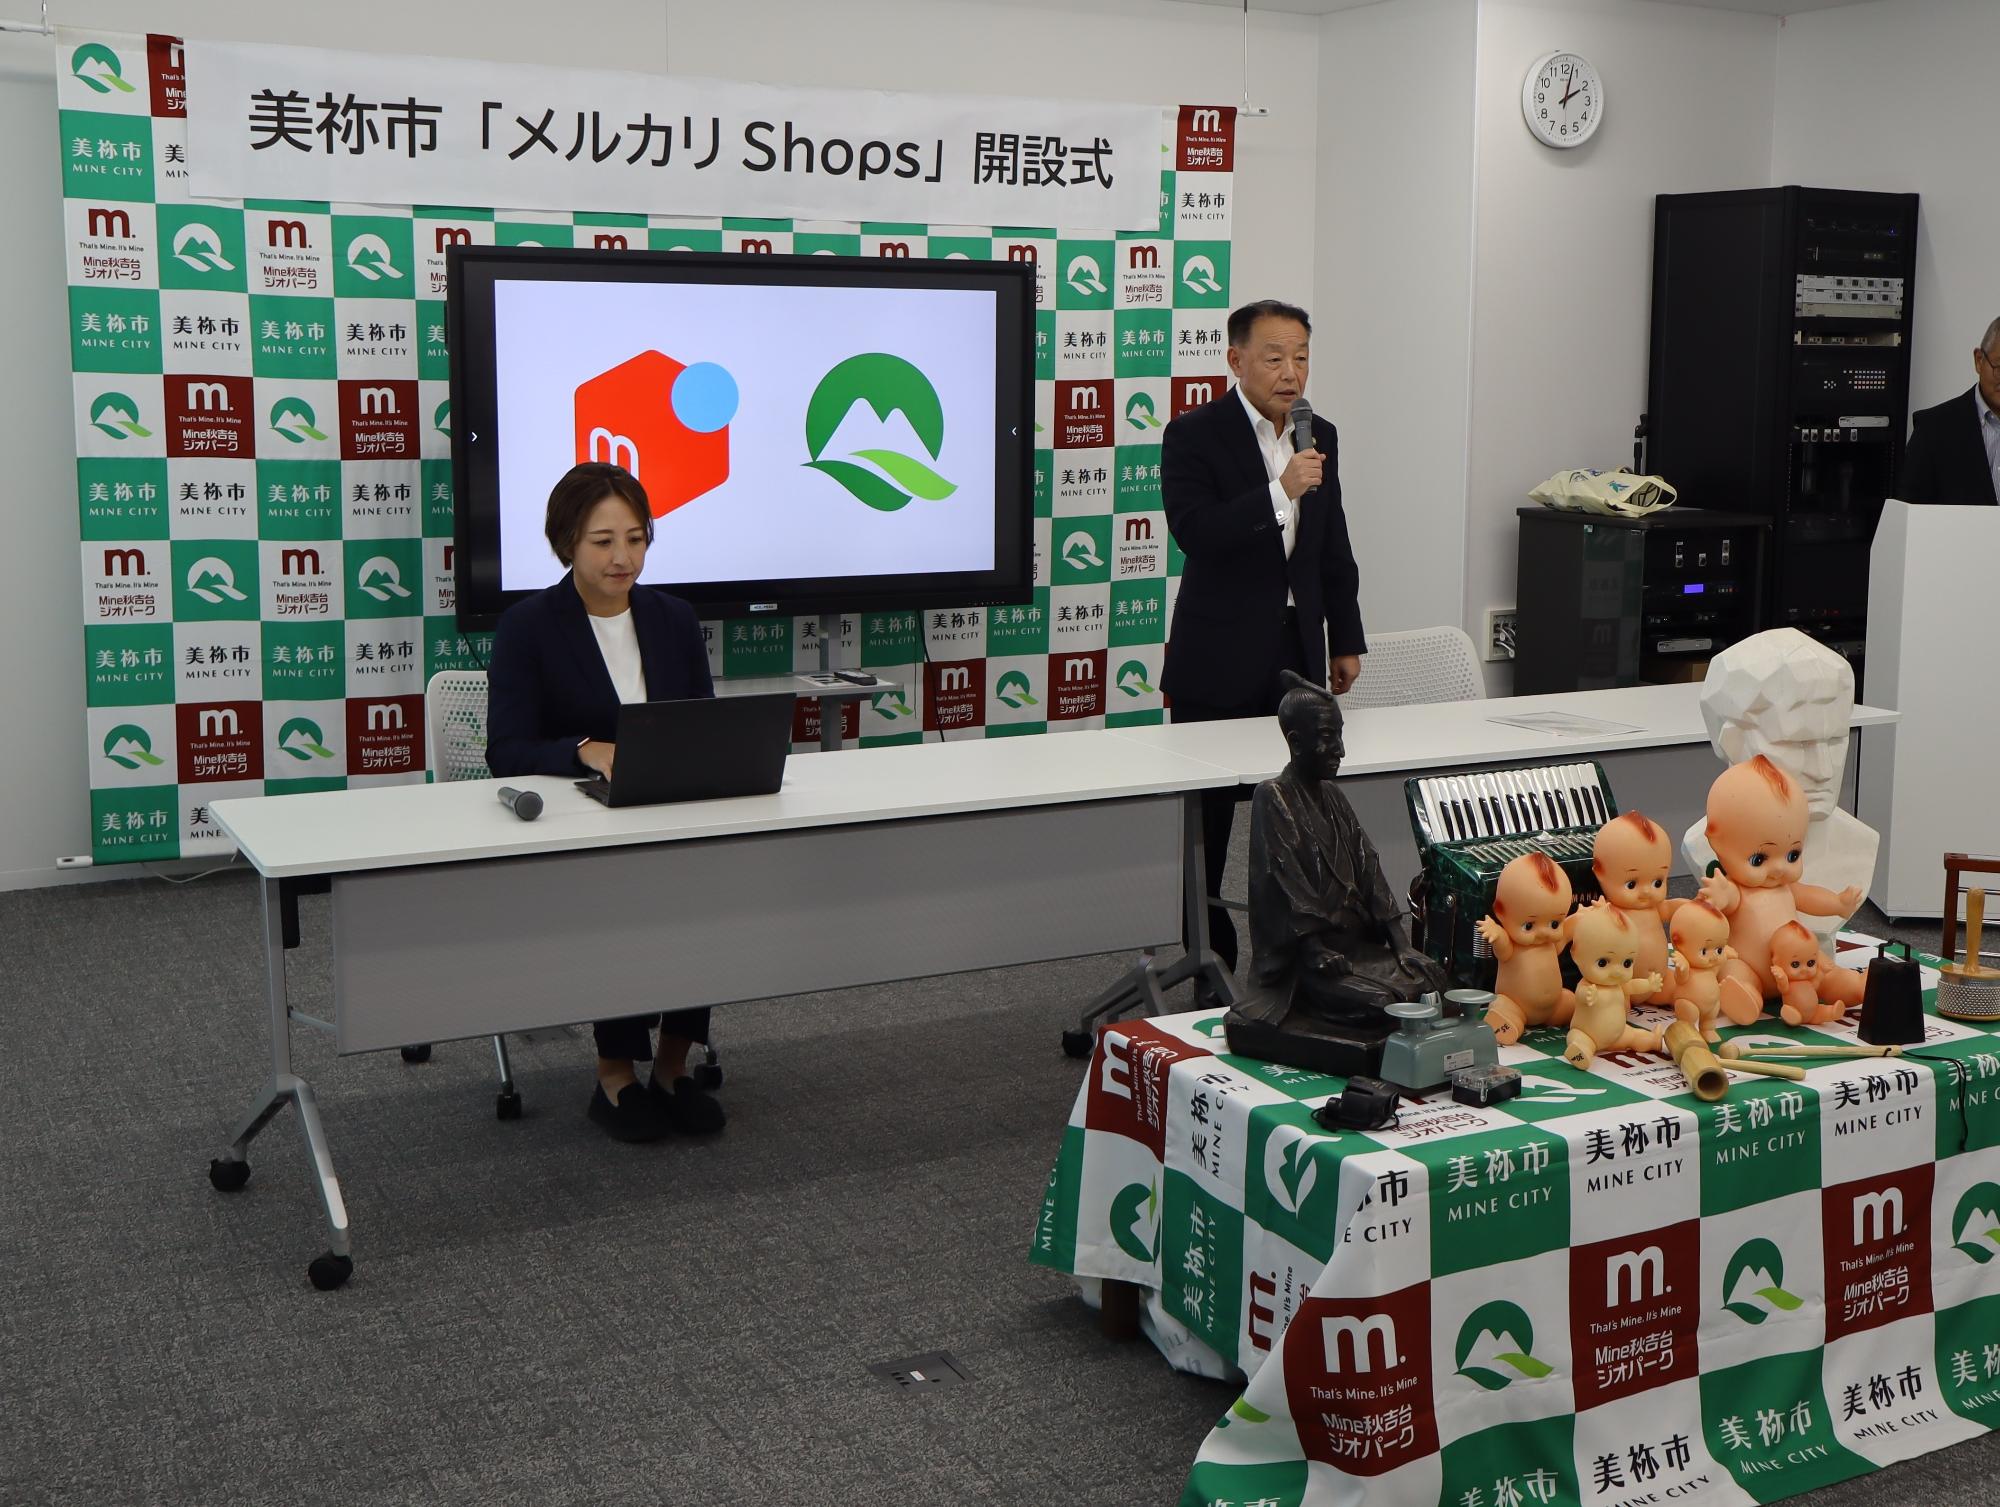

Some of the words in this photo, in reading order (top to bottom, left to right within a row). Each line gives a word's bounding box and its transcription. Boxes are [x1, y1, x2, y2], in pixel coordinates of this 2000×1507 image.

[1550, 67, 1556, 77] 11
[1561, 64, 1570, 74] 12
[1575, 68, 1578, 78] 1
[1541, 78, 1550, 88] 10
[1582, 80, 1588, 90] 2
[1538, 93, 1544, 103] 9
[1584, 96, 1590, 106] 3
[1541, 108, 1548, 118] 8
[1581, 111, 1587, 122] 4
[1550, 120, 1556, 130] 7
[1560, 125, 1567, 135] 6
[1573, 122, 1579, 132] 5
[72, 138, 141, 160] 美祢市
[73, 164, 106, 173] MINE
[114, 167, 142, 176] CITY
[1182, 193, 1224, 208] 美祢市
[84, 256, 140, 270] Mine秋吉台
[85, 268, 141, 281] ジオパーク
[81, 313, 149, 334] 美祢市
[173, 316, 239, 336] 美祢市
[262, 321, 324, 340] 美祢市
[347, 324, 406, 342] 美祢市
[1064, 332, 1106, 347] 美祢市
[81, 339, 115, 348] MINE
[122, 340, 151, 348] CITY
[173, 340, 206, 350] MINE
[212, 342, 240, 351] CITY
[262, 345, 292, 353] MINE
[299, 347, 326, 355] CITY
[183, 429, 237, 440] Mine秋吉台
[184, 440, 238, 451] ジオパーク
[1062, 468, 1106, 484] 美祢市
[180, 482, 245, 501] 美祢市
[353, 484, 411, 501] 美祢市
[218, 507, 246, 515] CITY
[99, 595, 154, 605] Mine秋吉台
[277, 594, 328, 604] Mine秋吉台
[100, 606, 155, 616] ジオパーク
[278, 604, 328, 614] ジオパーク
[1058, 604, 1103, 621] 美祢市
[187, 645, 250, 664] 美祢市
[357, 642, 413, 660] 美祢市
[186, 670, 216, 678] MINE
[356, 666, 384, 674] MINE
[391, 664, 413, 672] CITY
[194, 753, 246, 764] Mine秋吉台
[195, 764, 247, 776] ジオパーク
[102, 810, 168, 831] 美祢市
[102, 836, 133, 844] MINE
[140, 833, 168, 842] CITY
[1216, 1086, 1250, 1110] CITY
[1831, 1069, 1919, 1110] 美祢市
[1191, 1074, 1232, 1170] 美祢市
[1712, 1091, 1803, 1138] 美祢市
[1834, 1116, 1877, 1136] MINE
[1886, 1106, 1922, 1126] CITY
[1400, 1119, 1488, 1139] ジオパーク
[1584, 1116, 1680, 1164] 美祢市
[1717, 1142, 1759, 1164] MINE
[1768, 1131, 1805, 1152] CITY
[1212, 1122, 1223, 1178] MINE
[1447, 1141, 1549, 1194] 美祢市
[1588, 1170, 1633, 1193] MINE
[1644, 1158, 1683, 1180] CITY
[1448, 1194, 1498, 1223] MINE
[1509, 1187, 1552, 1208] CITY
[1041, 1198, 1054, 1250] MINE
[1364, 1218, 1412, 1242] CITY
[1896, 1242, 1914, 1255] Mine
[1183, 1201, 1205, 1322] 美祢市
[1284, 1266, 1292, 1296] Mine
[1844, 1266, 1908, 1301] Mine秋吉台
[1207, 1279, 1216, 1332] MINE
[1660, 1304, 1682, 1318] Mine
[1844, 1286, 1909, 1322] ジオパーク
[1595, 1330, 1672, 1366] Mine秋吉台
[1598, 1352, 1673, 1389] ジオパーク
[1396, 1376, 1418, 1391] Mine
[1843, 1366, 1922, 1422] 美祢市
[1322, 1403, 1412, 1434] Mine秋吉台
[1719, 1400, 1811, 1450] 美祢市
[1854, 1421, 1896, 1440] MINE
[1901, 1409, 1938, 1426] CITY
[1330, 1424, 1414, 1459] ジオパーク
[1593, 1434, 1690, 1494] 美祢市
[1741, 1459, 1783, 1474] MINE
[1788, 1444, 1828, 1464] CITY
[1666, 1474, 1710, 1497] CITY
